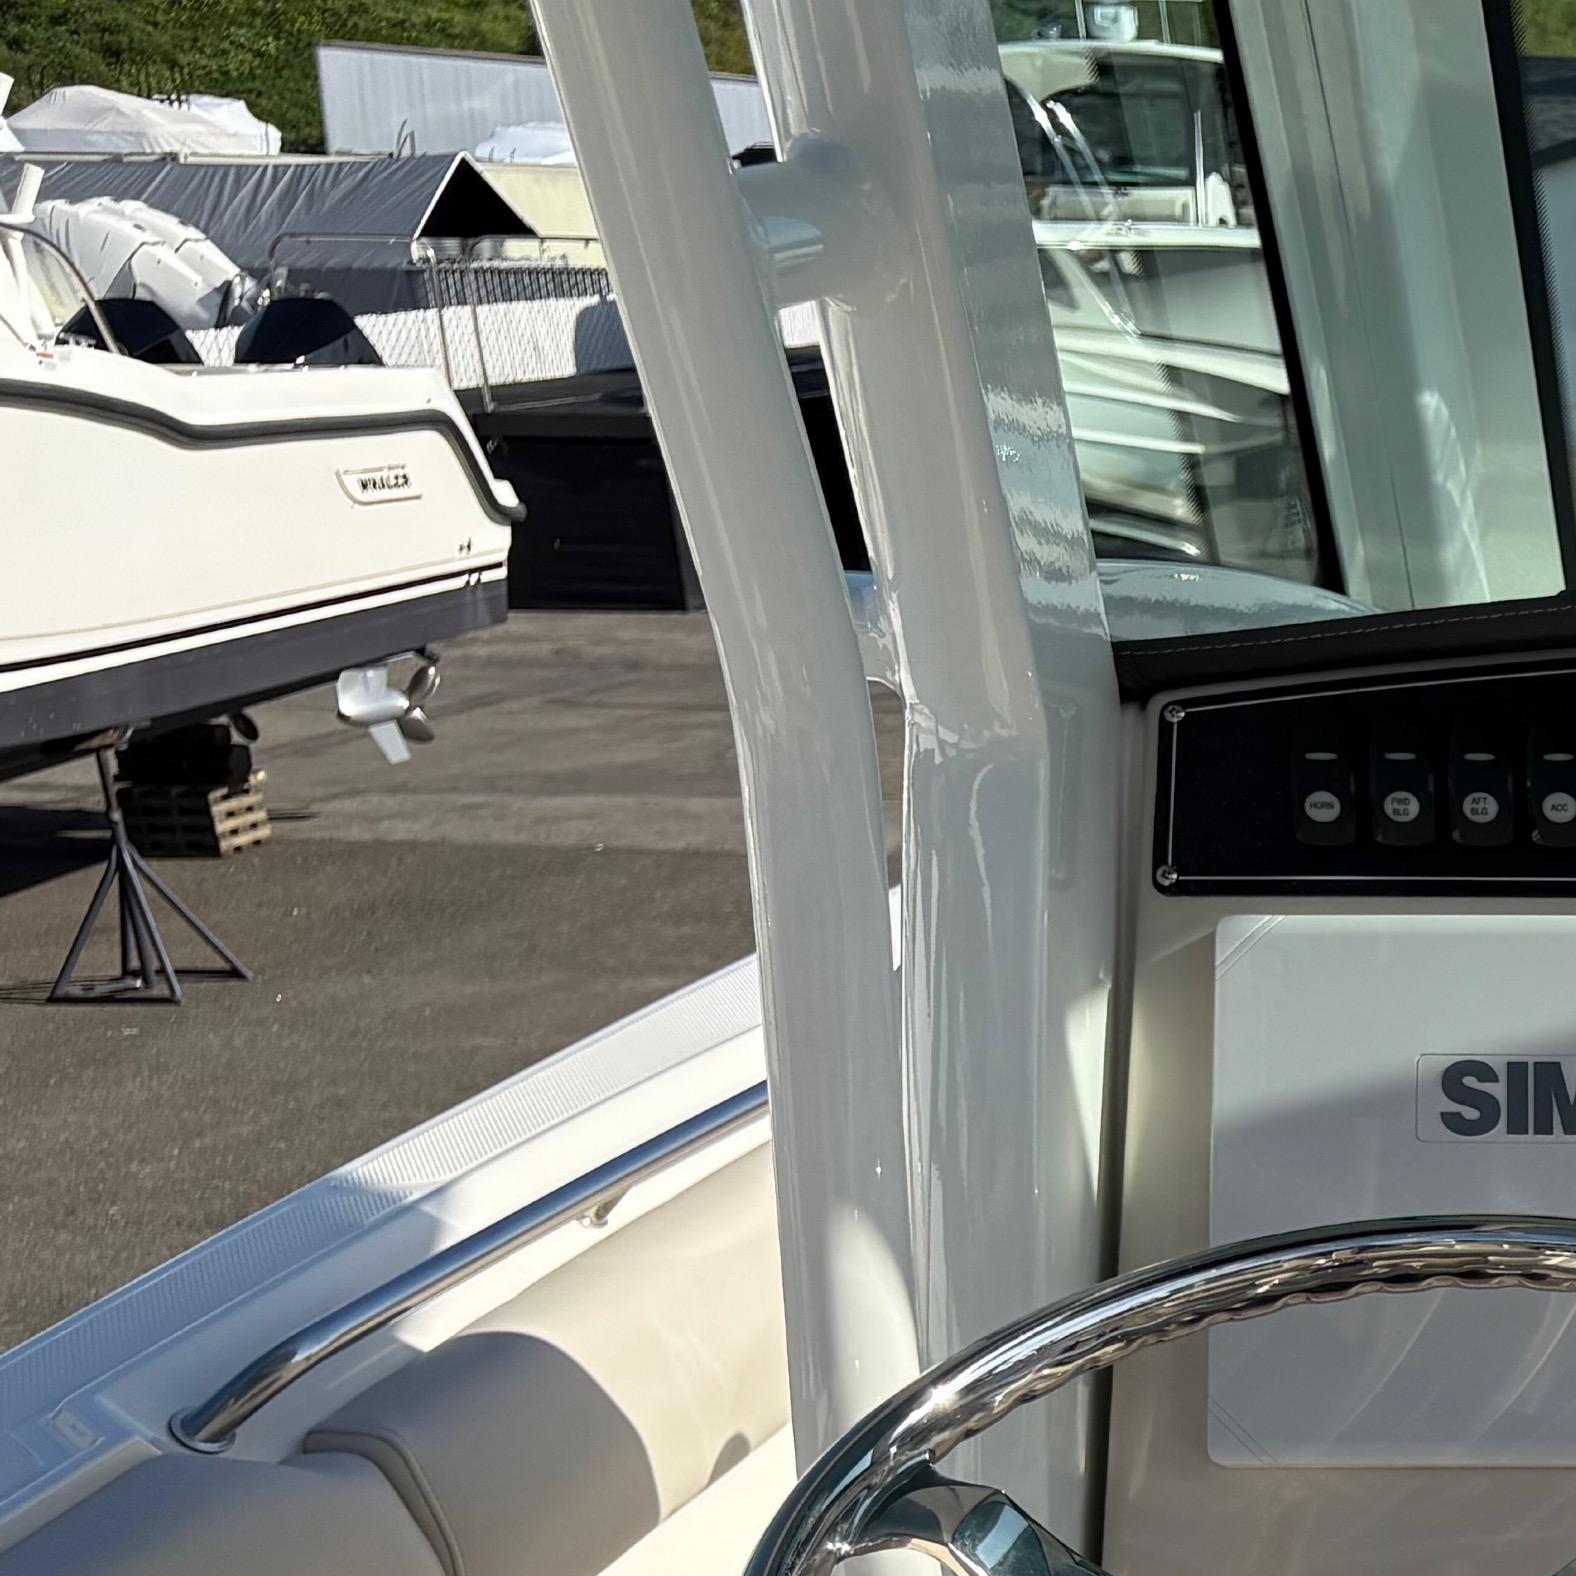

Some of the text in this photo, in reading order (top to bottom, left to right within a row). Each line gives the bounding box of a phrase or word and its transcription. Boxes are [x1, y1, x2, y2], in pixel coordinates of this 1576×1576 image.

[1309, 802, 1334, 810] HORN
[1470, 797, 1488, 806] AFT
[1551, 803, 1569, 812] ACC
